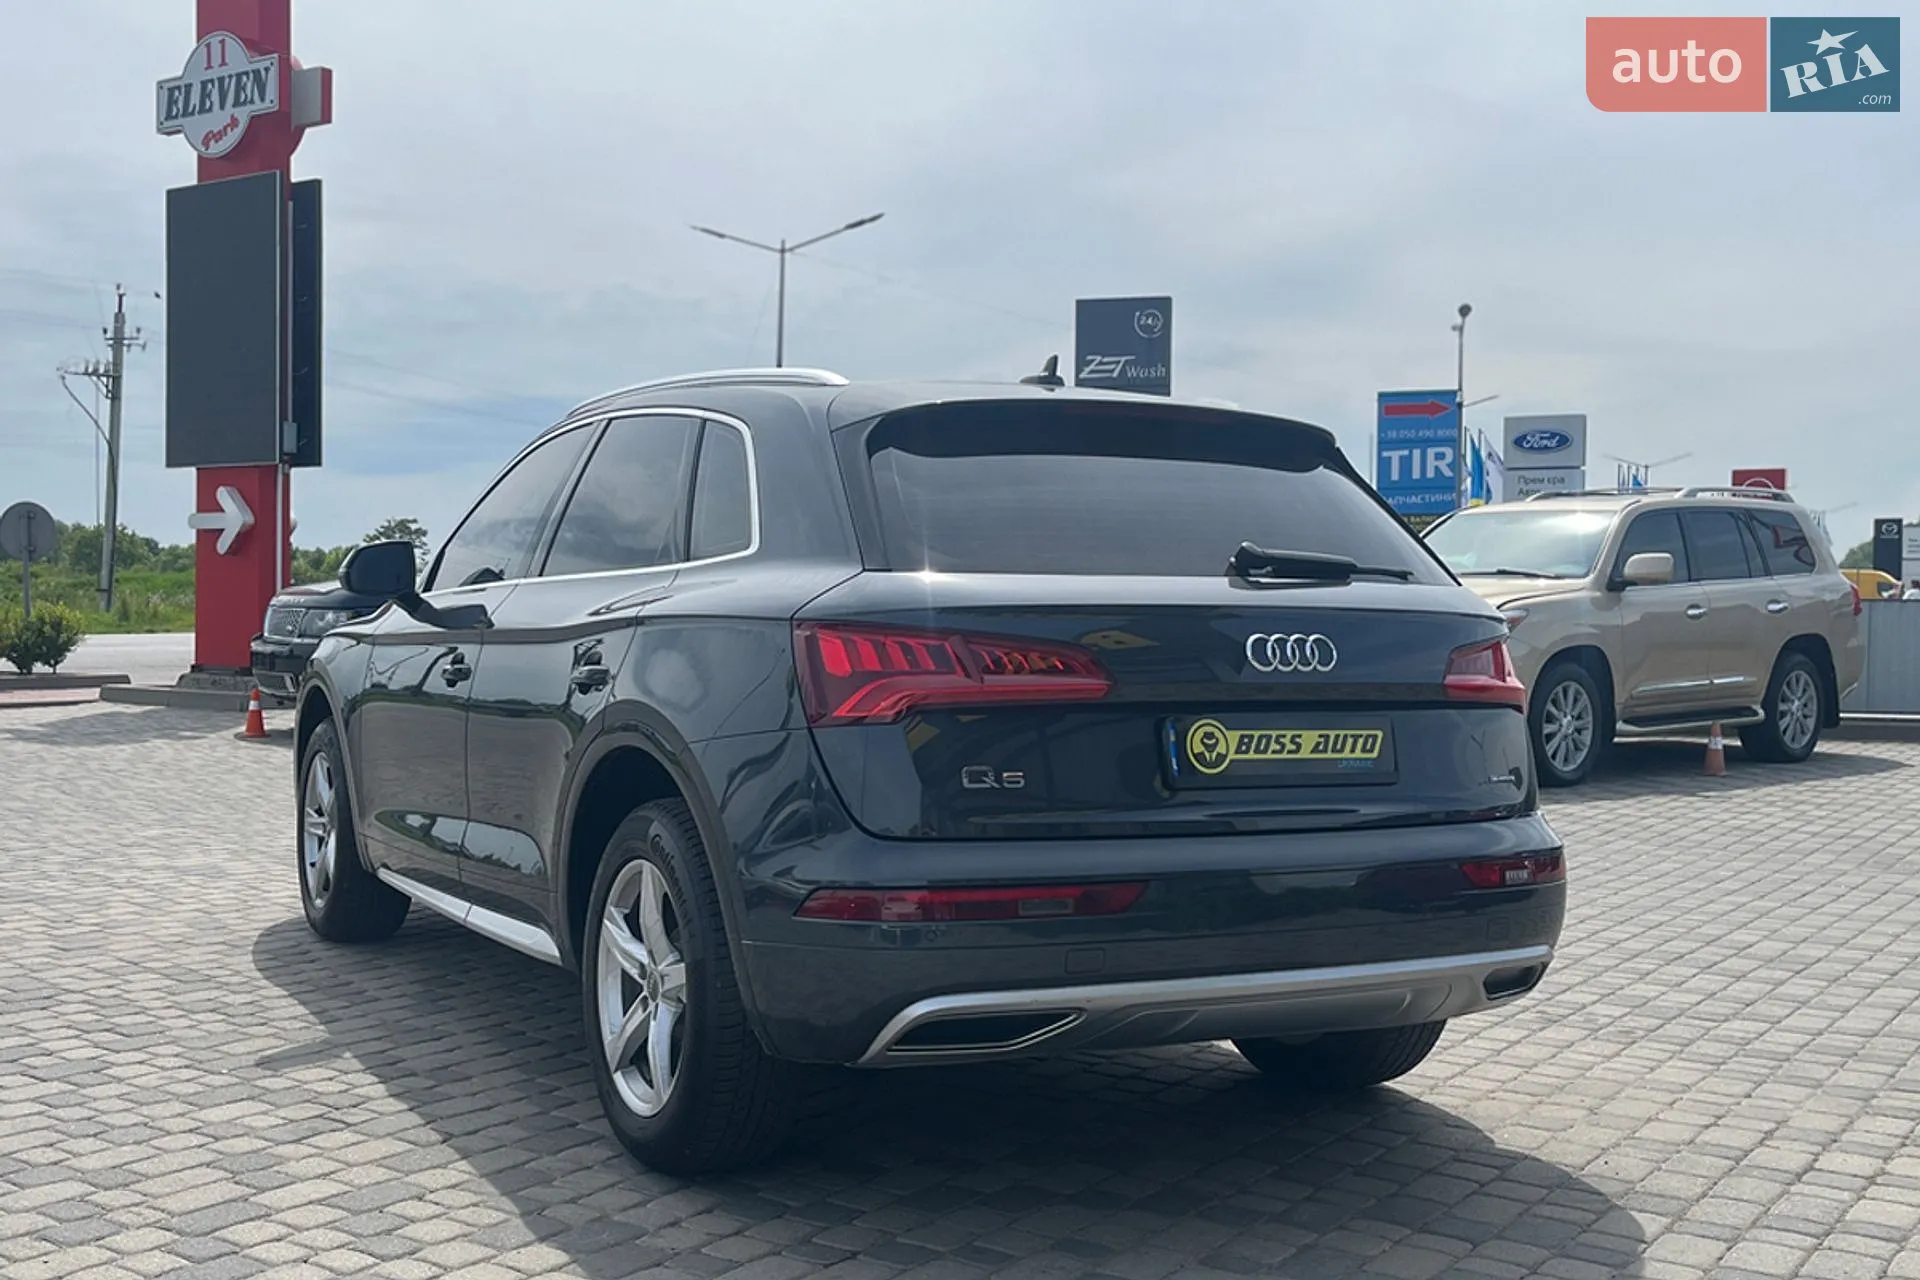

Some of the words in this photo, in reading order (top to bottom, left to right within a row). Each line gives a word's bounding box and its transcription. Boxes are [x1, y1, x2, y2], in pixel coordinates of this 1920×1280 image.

[204, 38, 228, 70] 11
[164, 66, 271, 121] ELEVEN
[202, 114, 240, 151] Park
[1125, 363, 1166, 378] Wash
[1523, 433, 1560, 448] Ford
[1382, 447, 1454, 481] TIR
[1234, 734, 1302, 755] BOSS
[1310, 733, 1378, 754] AUTO
[961, 765, 1025, 788] Q5
